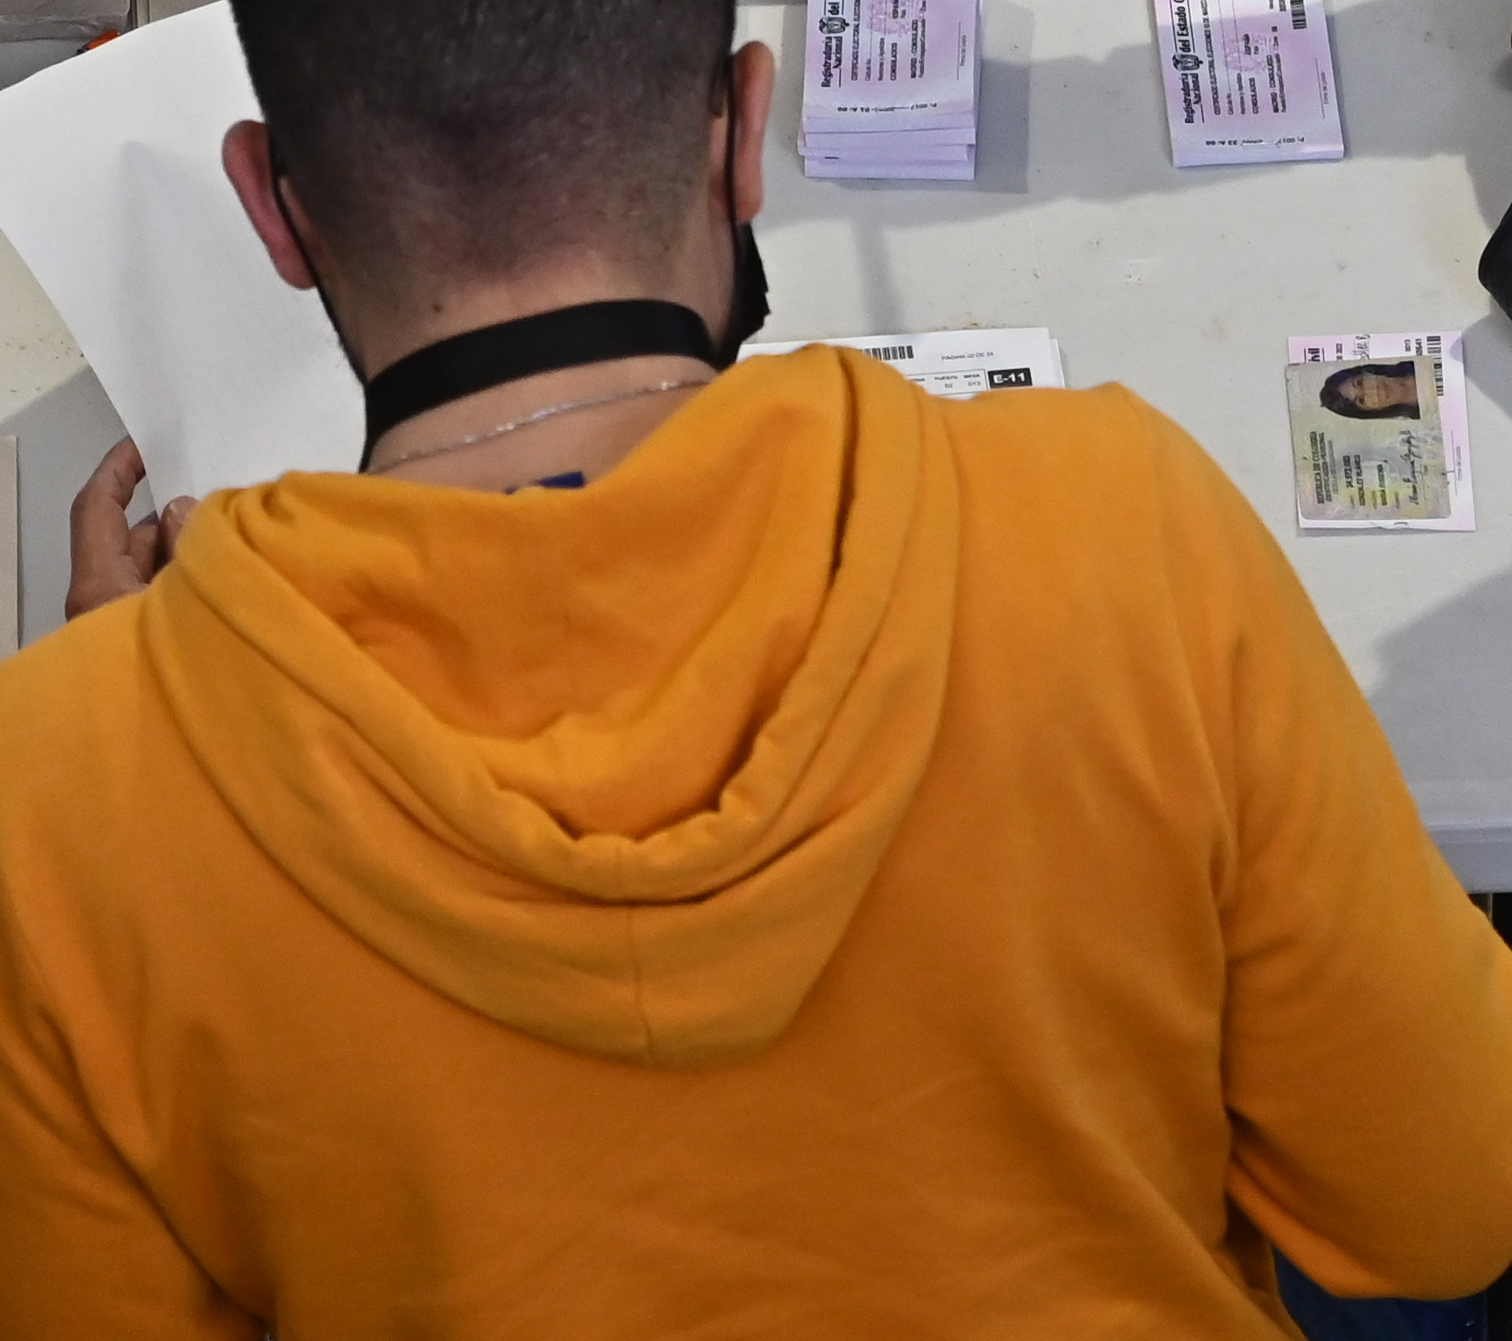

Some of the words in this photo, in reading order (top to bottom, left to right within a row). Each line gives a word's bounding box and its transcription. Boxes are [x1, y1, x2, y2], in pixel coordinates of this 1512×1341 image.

[828, 1, 839, 15] del
[1175, 6, 1188, 36] Estado
[1179, 40, 1191, 53] del
[993, 372, 1026, 384] E-11
